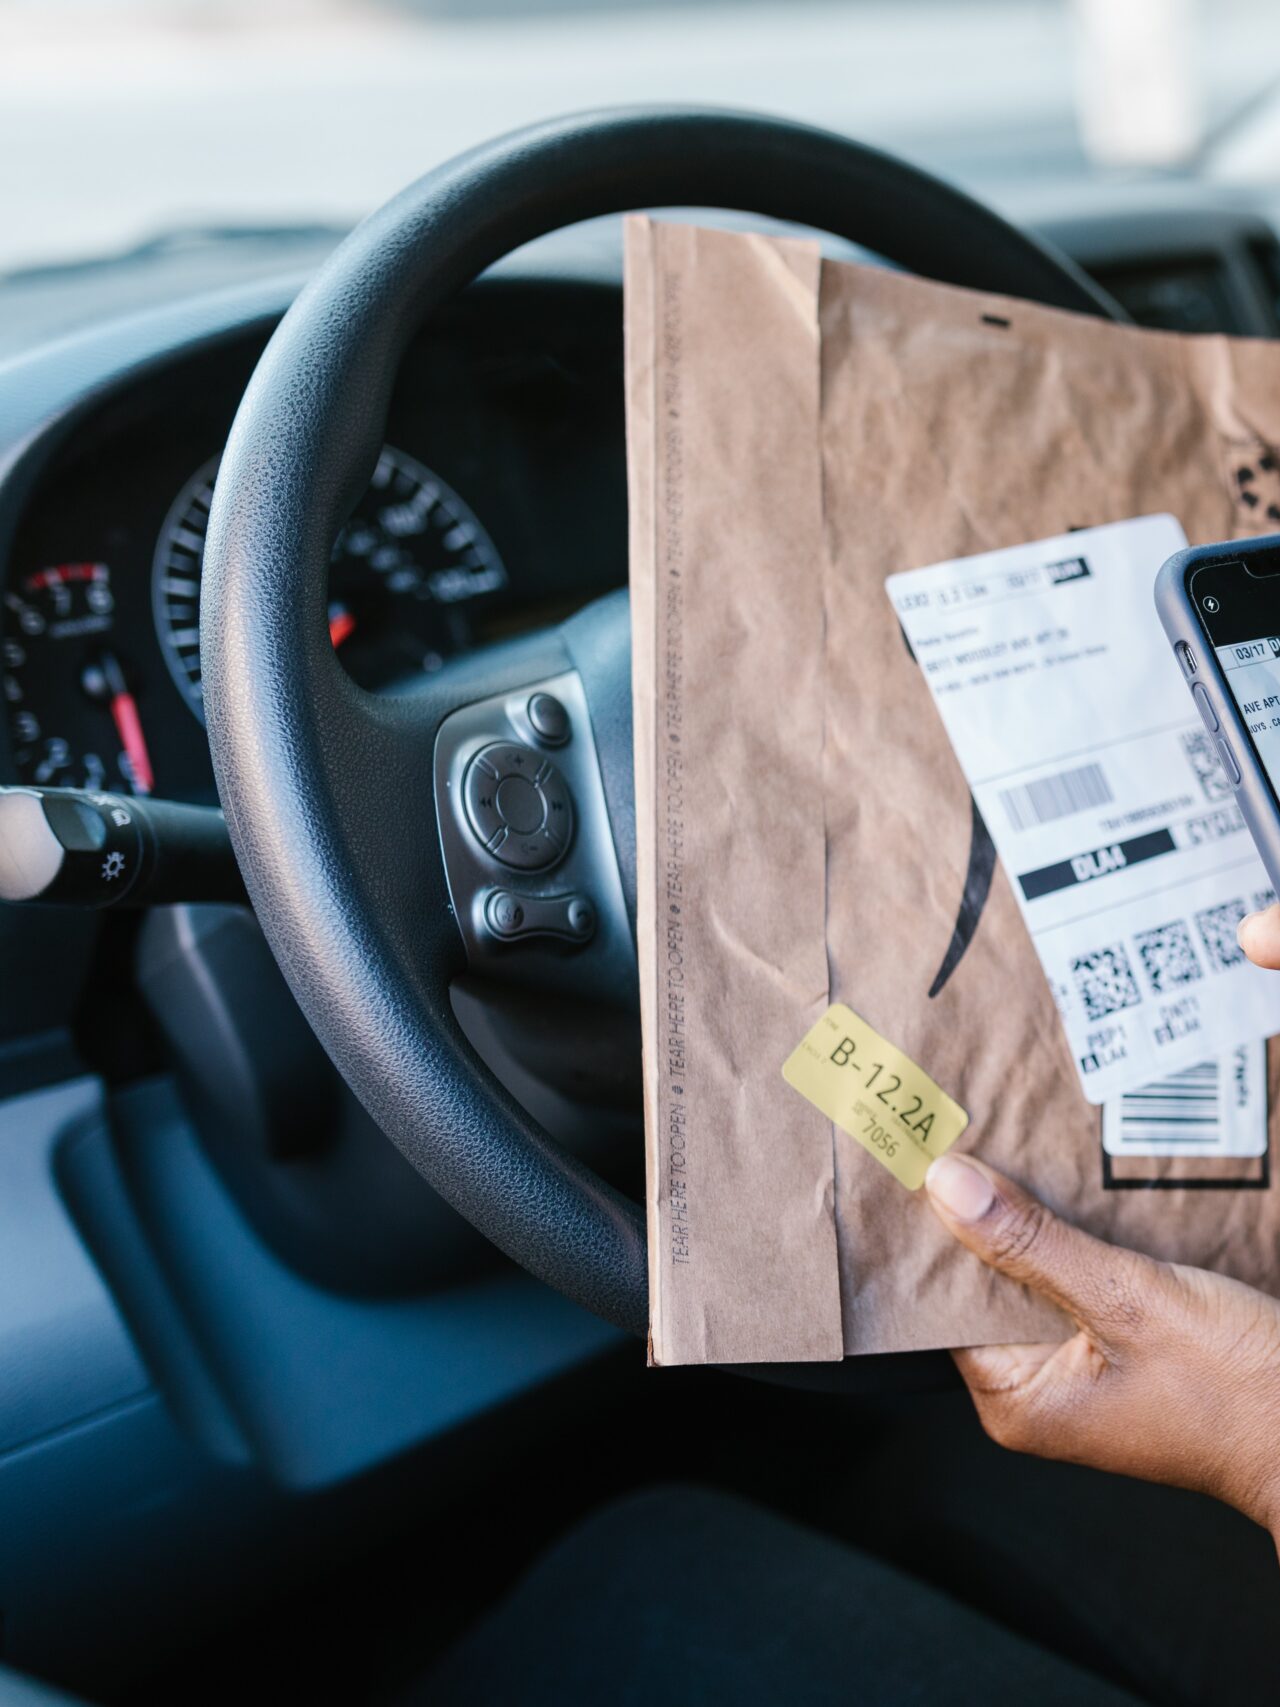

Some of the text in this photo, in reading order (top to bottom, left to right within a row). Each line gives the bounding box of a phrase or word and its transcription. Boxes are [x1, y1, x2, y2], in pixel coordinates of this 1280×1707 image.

[1235, 643, 1266, 660] 03/17
[1243, 700, 1262, 715] AVE
[1262, 695, 1280, 709] APT
[667, 750, 682, 793] OPEN
[667, 795, 682, 814] TO
[667, 818, 683, 860] HERE
[667, 862, 682, 900] TEAR
[1071, 844, 1127, 882] DLA4
[667, 920, 684, 965] OPEN
[667, 968, 684, 989] TO
[668, 993, 685, 1035] HERE
[668, 1038, 685, 1077] TEAR
[830, 1037, 935, 1142] B-12.2A
[669, 1103, 686, 1150] OPEN
[862, 1117, 900, 1158] 7056
[670, 1152, 686, 1175] TO
[670, 1180, 688, 1223] HERE
[671, 1225, 690, 1265] TEAR
